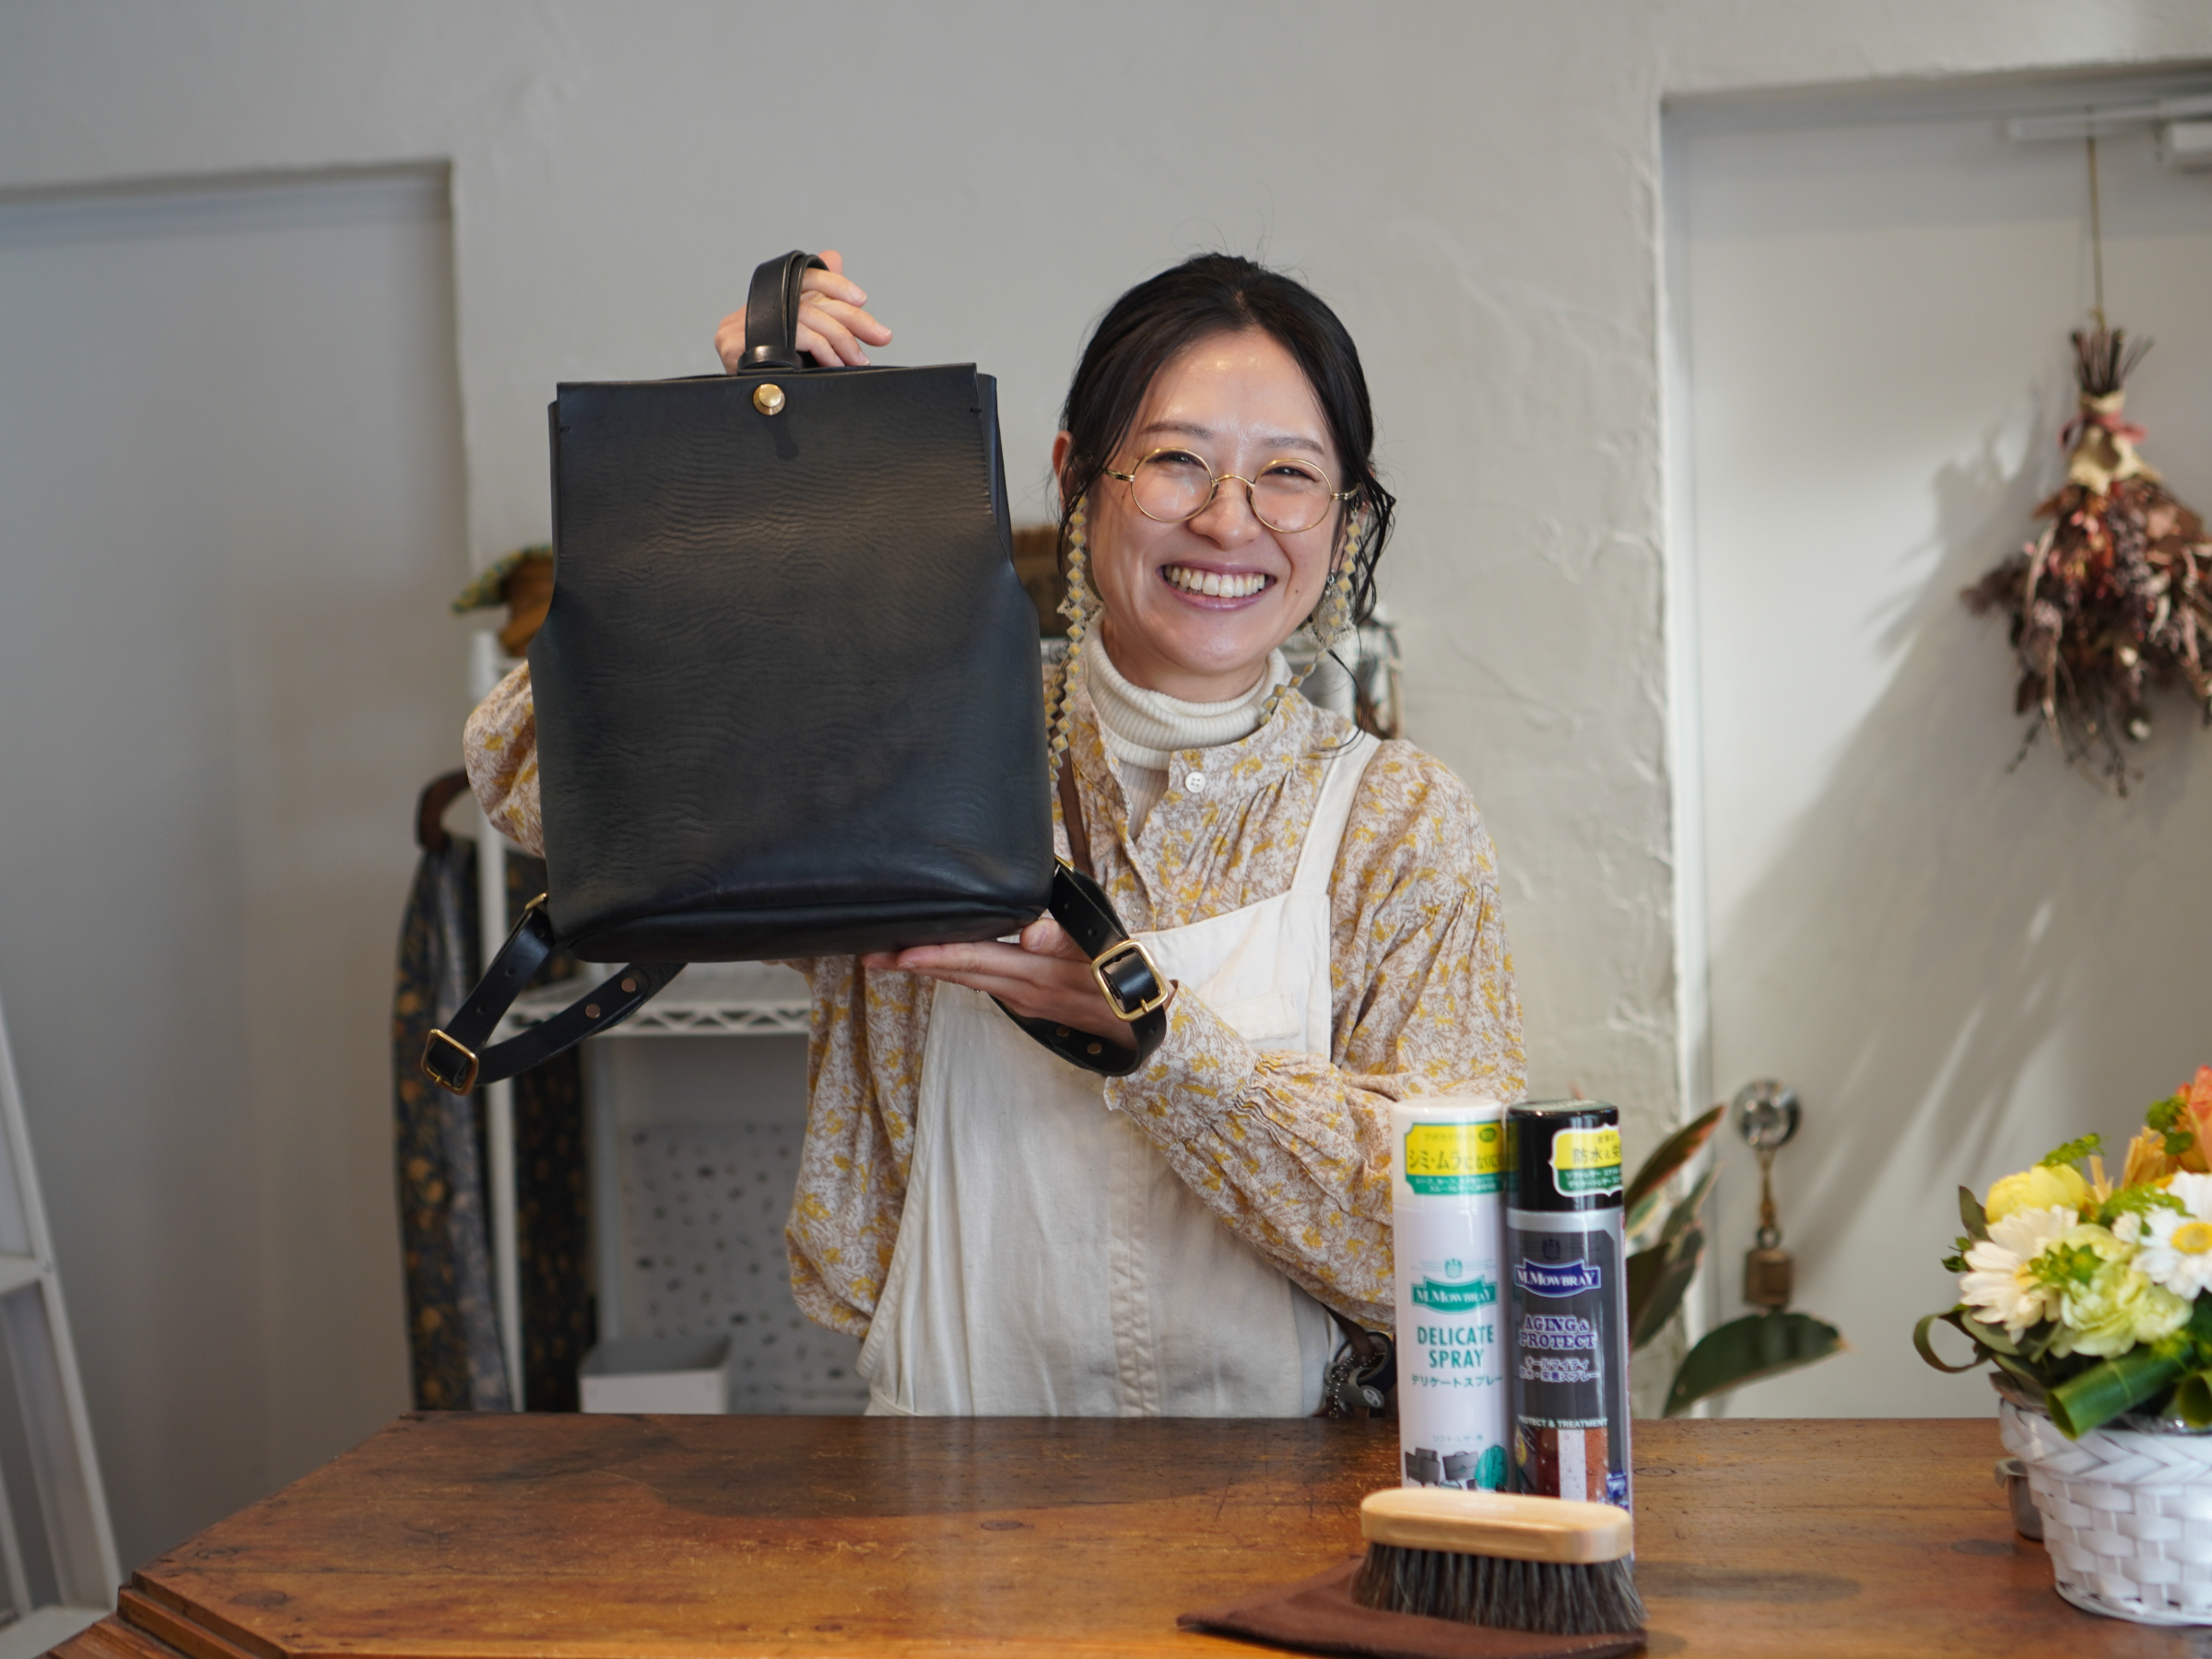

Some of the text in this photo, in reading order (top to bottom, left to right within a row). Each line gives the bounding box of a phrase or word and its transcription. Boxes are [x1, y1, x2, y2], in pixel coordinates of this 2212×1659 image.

[1524, 1313, 1578, 1334] AGING
[1417, 1324, 1495, 1346] DELICATE
[1519, 1330, 1598, 1350] PROTECT
[1429, 1348, 1485, 1369] SPRAY
[1411, 1373, 1503, 1388] デリケートスプレー
[1519, 1414, 1609, 1429] PROTECT & TREATMENT
